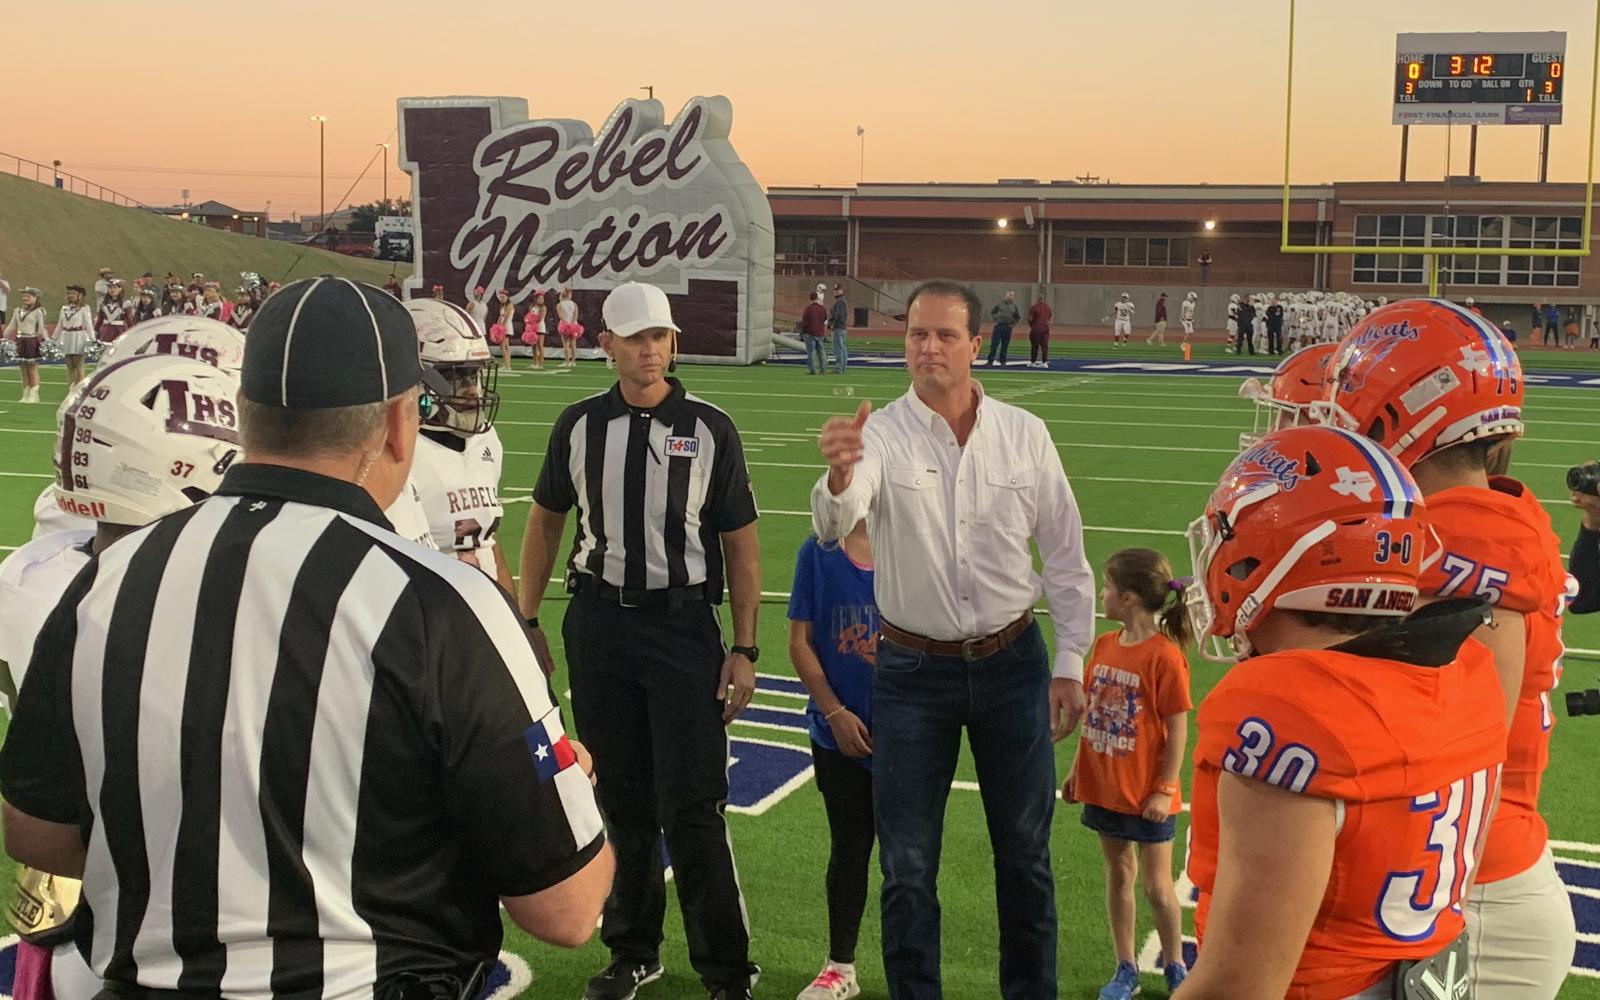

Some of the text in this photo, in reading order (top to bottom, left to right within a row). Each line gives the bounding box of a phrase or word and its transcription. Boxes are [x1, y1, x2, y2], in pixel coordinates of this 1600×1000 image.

[1397, 54, 1425, 64] HOME
[1532, 53, 1563, 63] GUEST
[1408, 63, 1420, 79] 0
[1550, 63, 1561, 78] 0
[1405, 82, 1413, 94] 3
[1418, 80, 1443, 89] DOWN
[1449, 80, 1473, 89] TO GO
[1481, 80, 1511, 88] BALL ON
[1518, 80, 1535, 88] QTR
[1544, 81, 1553, 93] 3
[480, 104, 703, 220] Rebel
[458, 211, 728, 294] Nation
[76, 428, 92, 444] 98
[73, 451, 89, 467] 83
[170, 460, 195, 479] 37
[74, 474, 89, 490] 61
[1374, 530, 1413, 566] 30
[1435, 551, 1510, 607] 75
[1325, 587, 1373, 609] SAN
[1222, 716, 1320, 793] 30
